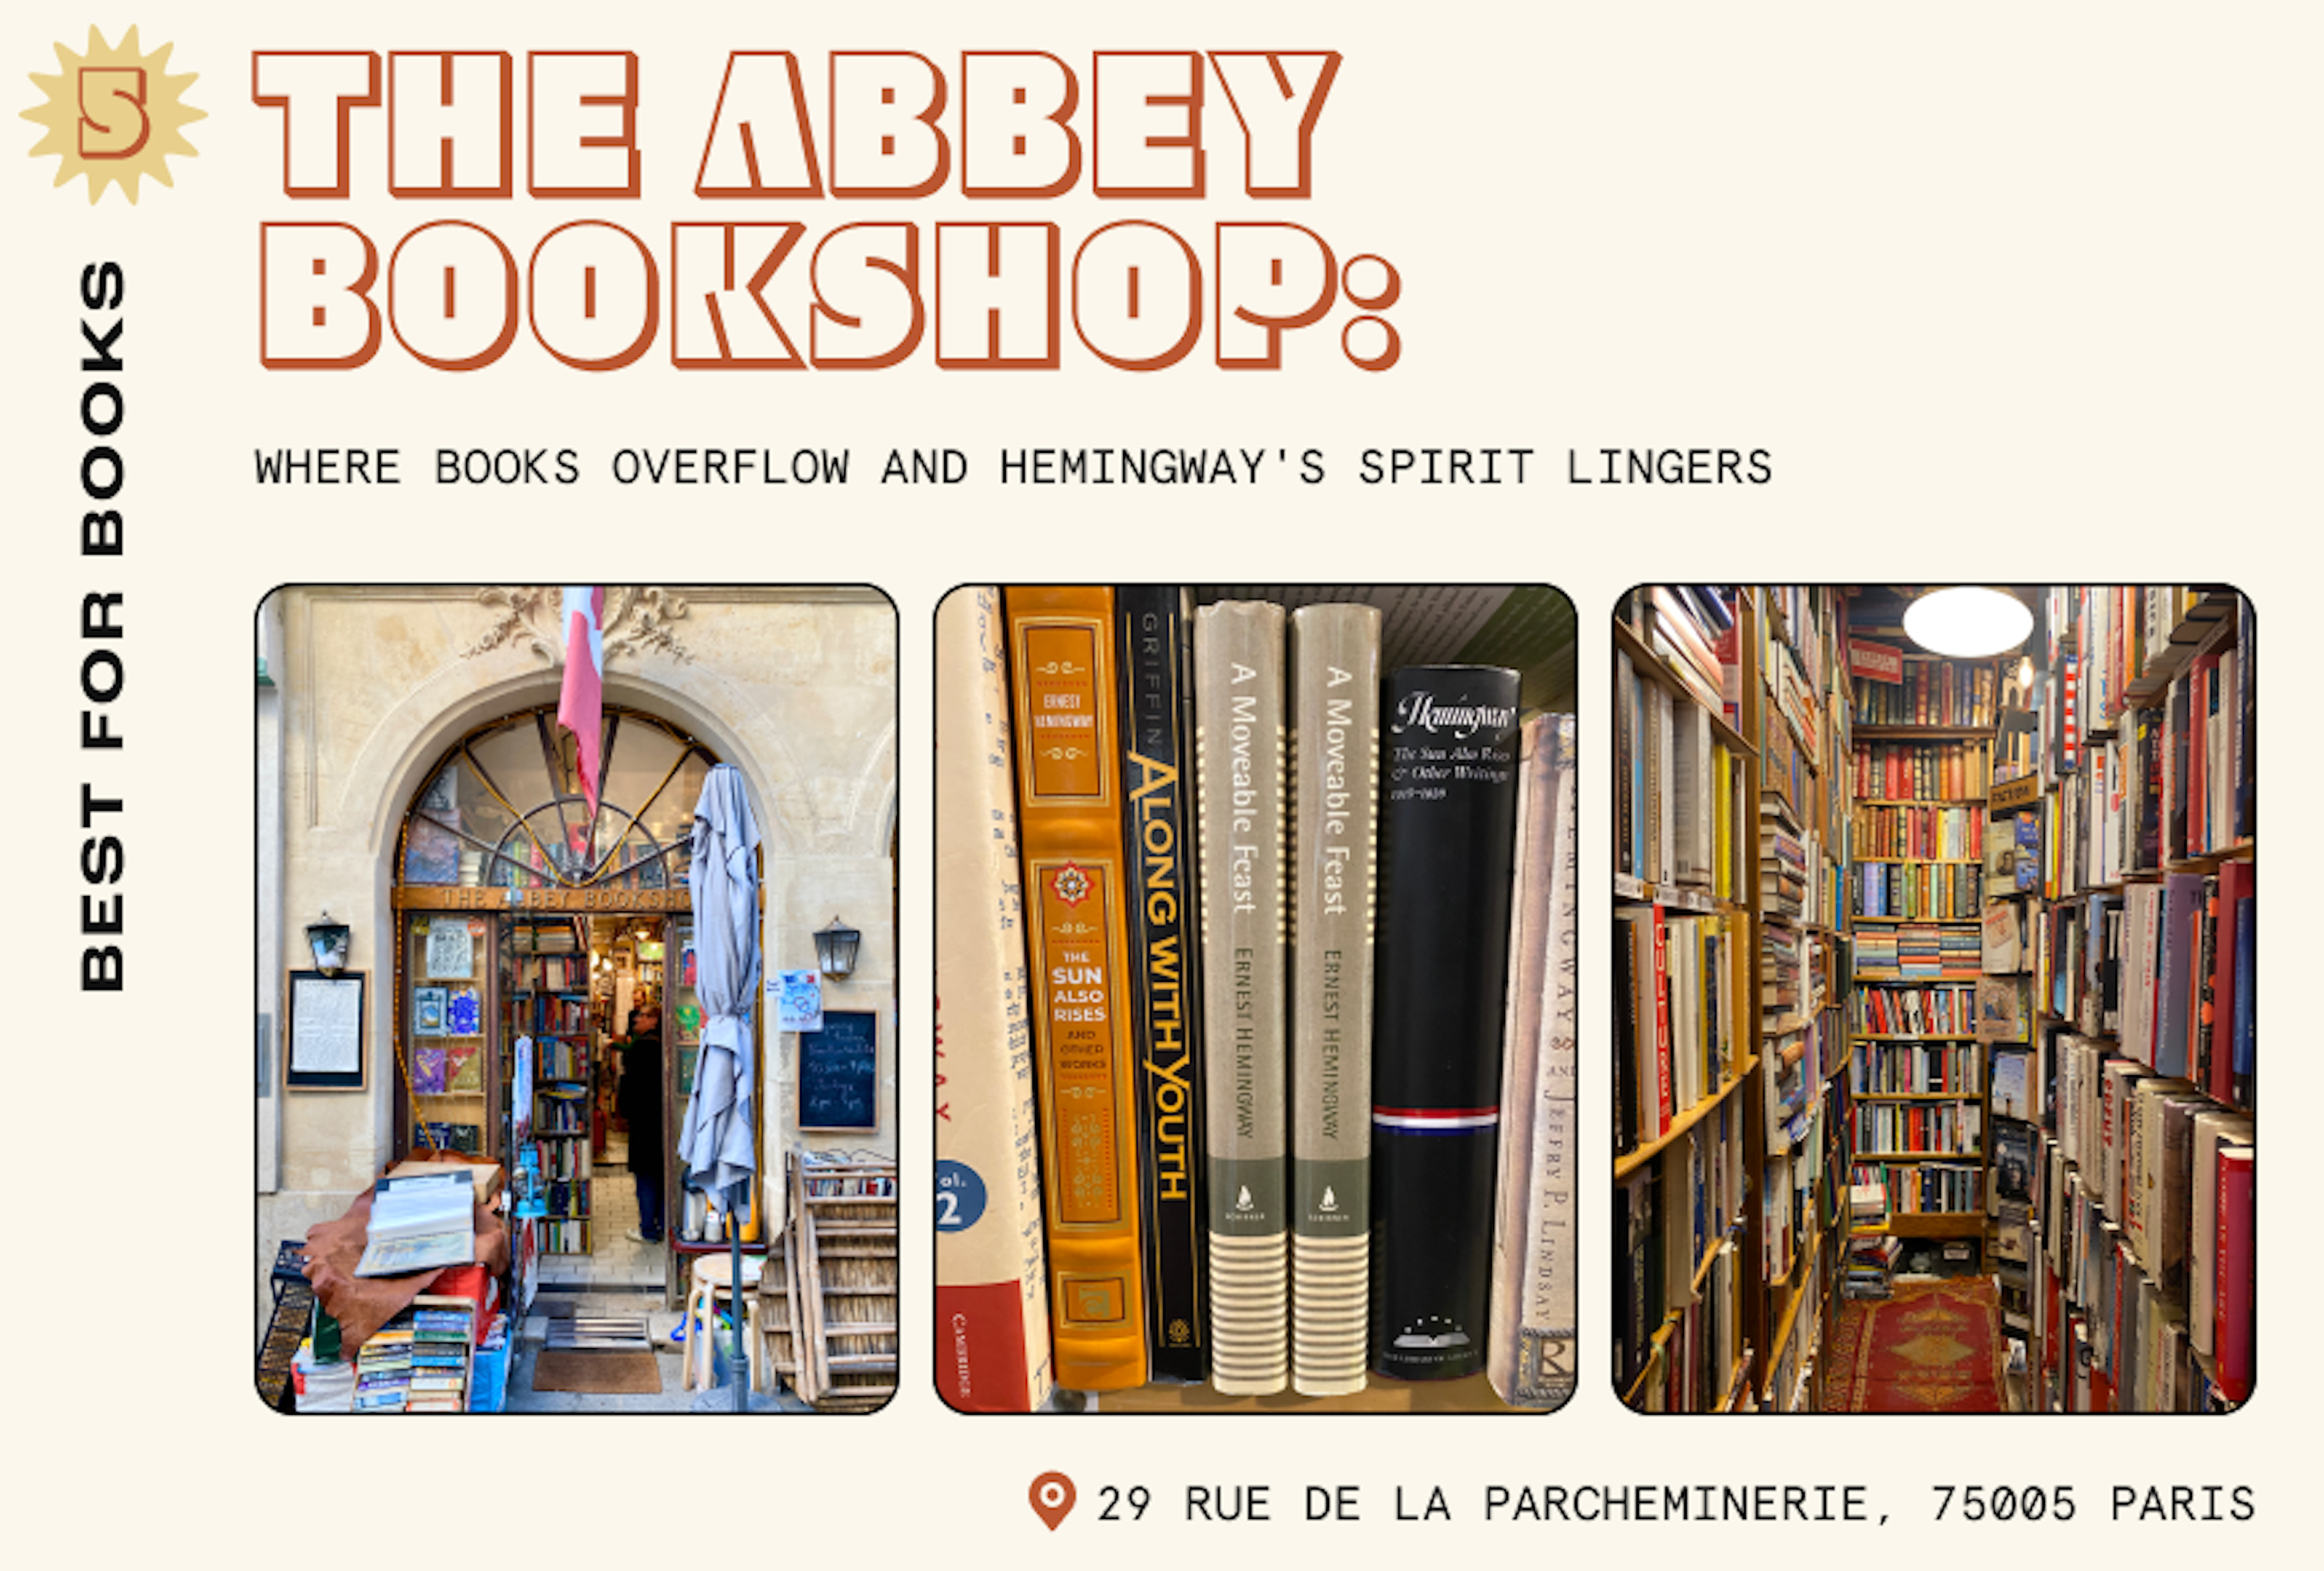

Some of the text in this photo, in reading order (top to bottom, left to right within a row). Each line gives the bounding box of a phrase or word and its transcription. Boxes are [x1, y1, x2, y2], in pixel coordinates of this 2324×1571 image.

[1141, 613, 1163, 745] GRIFFIN
[1043, 694, 1081, 709] ERNEST
[1230, 662, 1259, 915] A Moveable Feast
[1324, 667, 1353, 915] A Moveable Feast
[441, 889, 487, 909] THE
[496, 889, 571, 909] ABEY
[1063, 951, 1090, 964] THE
[1051, 967, 1103, 985] SUN
[1127, 749, 1190, 1200] ALONG WITH YOUTH
[1053, 989, 1105, 1003] ALSO
[1053, 1007, 1107, 1023] RISES
[1066, 1030, 1096, 1041] AND
[1234, 948, 1254, 1139] ERNEST HEMINGWAY
[1322, 950, 1342, 1141] ERNEST HEMINGWAY
[936, 1171, 966, 1187] ol.
[936, 1192, 962, 1225] 2
[1543, 1190, 1569, 1208] P.
[1535, 1219, 1566, 1321] LINDSAY
